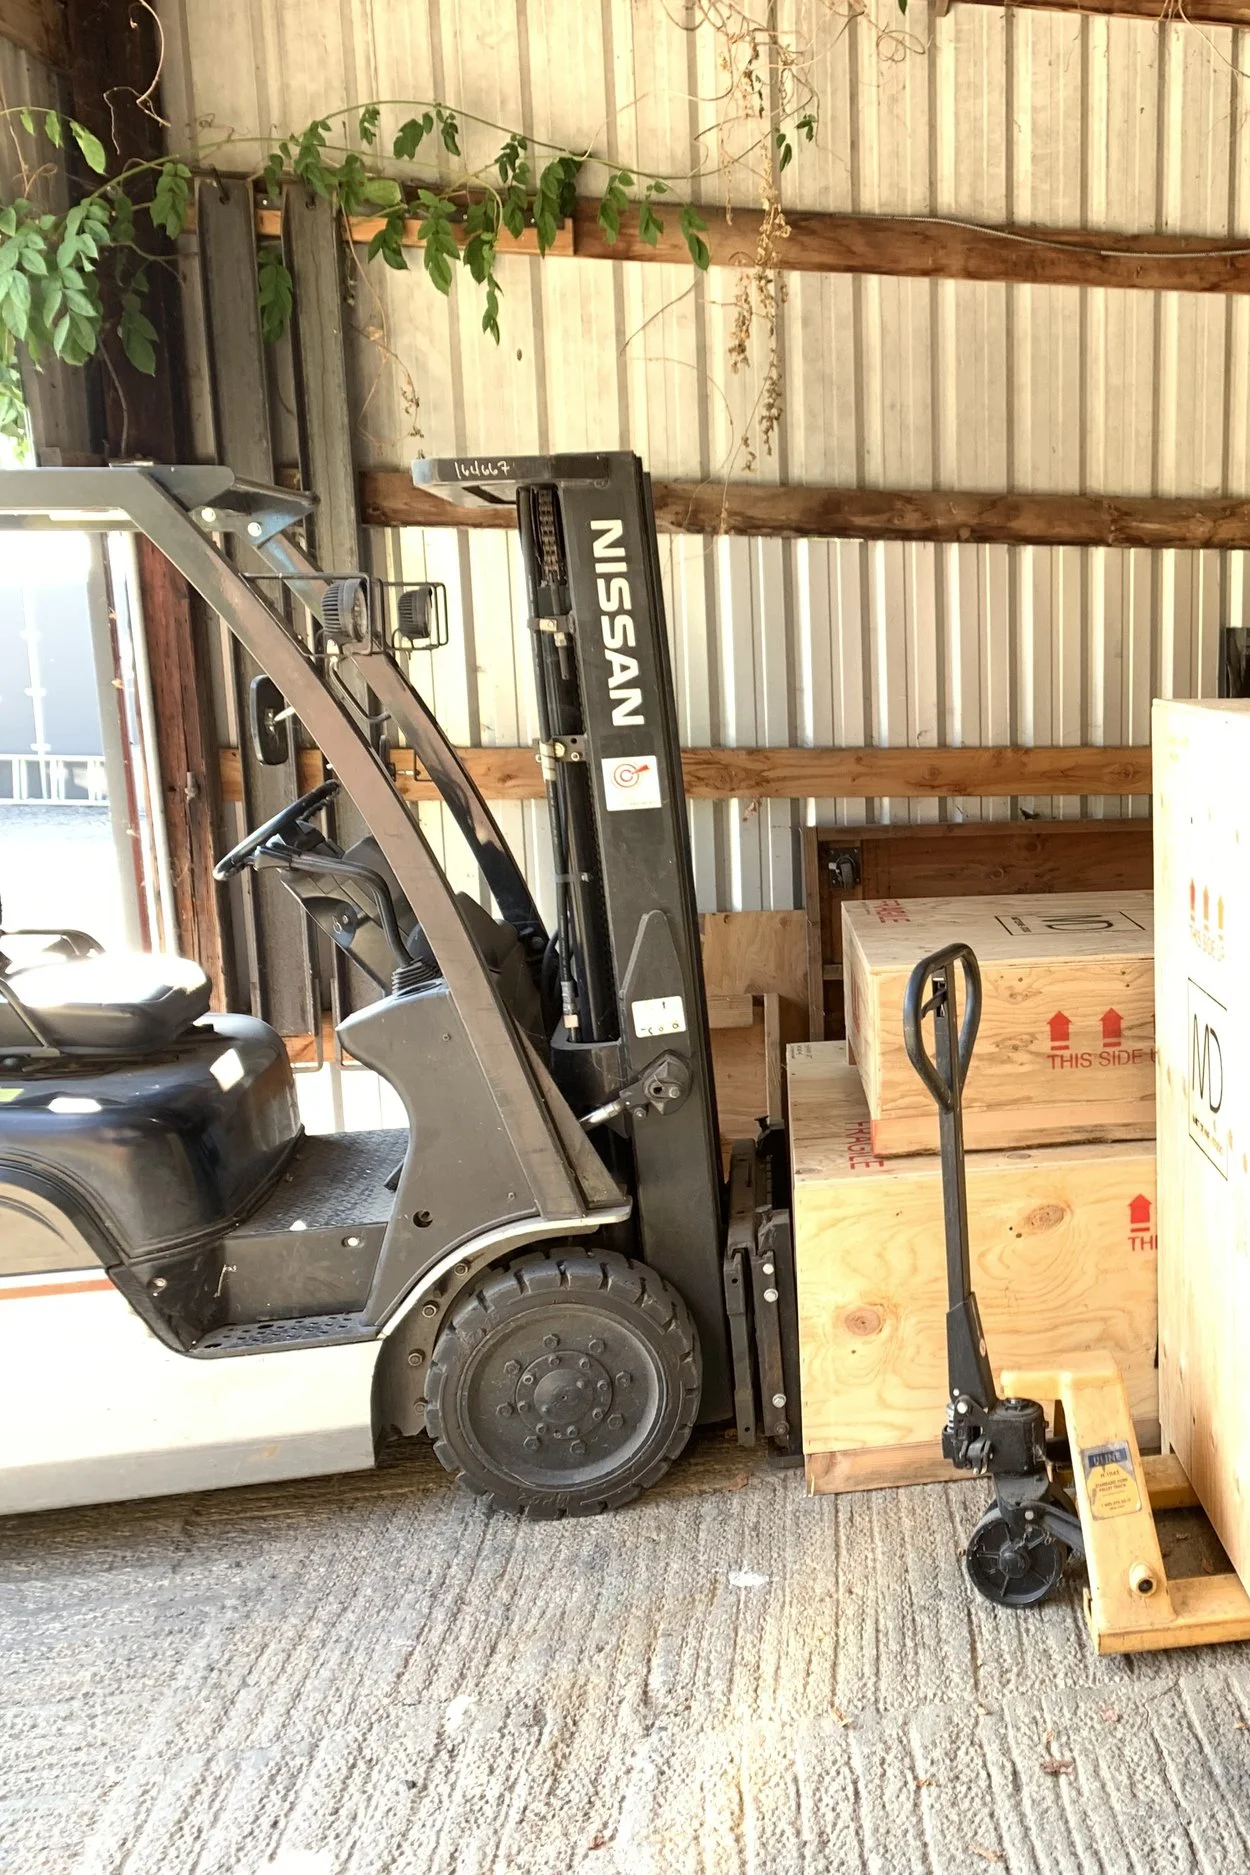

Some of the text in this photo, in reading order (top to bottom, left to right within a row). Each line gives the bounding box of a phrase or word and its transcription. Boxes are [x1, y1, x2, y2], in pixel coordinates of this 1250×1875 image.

[590, 519, 645, 727] NISSAN
[1046, 1052, 1092, 1070] THIS
[1098, 1048, 1143, 1067] SIDE
[1192, 1012, 1224, 1114] MD
